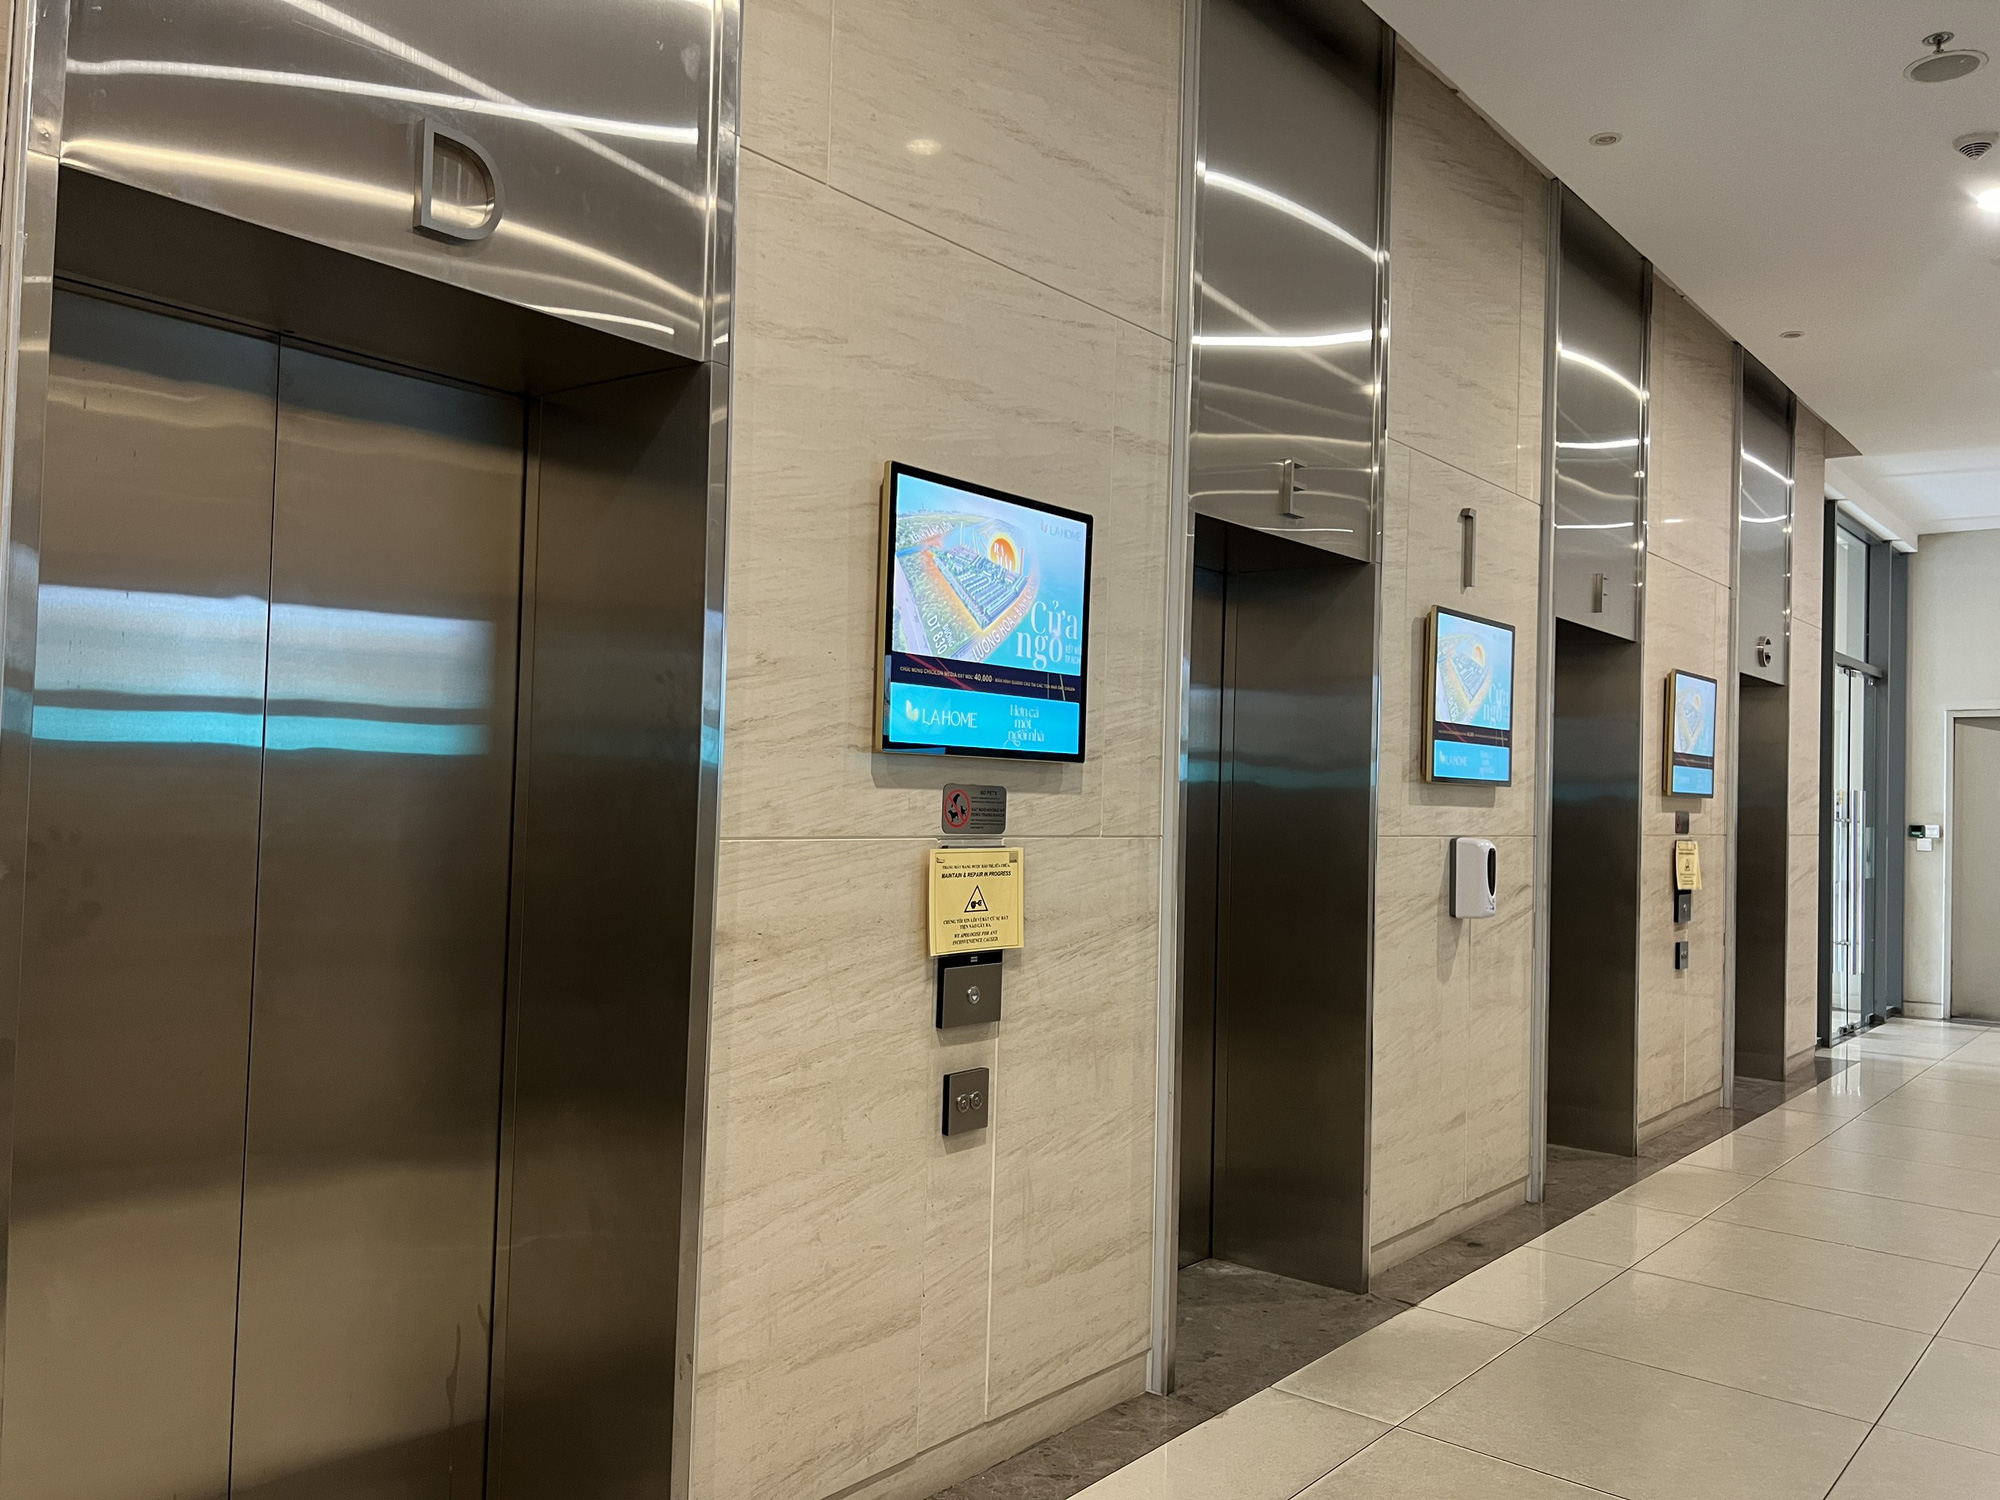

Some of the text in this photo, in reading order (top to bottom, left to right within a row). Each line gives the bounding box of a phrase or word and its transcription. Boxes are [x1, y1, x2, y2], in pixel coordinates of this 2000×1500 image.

[413, 117, 504, 240] D
[1283, 456, 1308, 519] E
[933, 631, 948, 655] 830
[1030, 600, 1078, 640] Cửa
